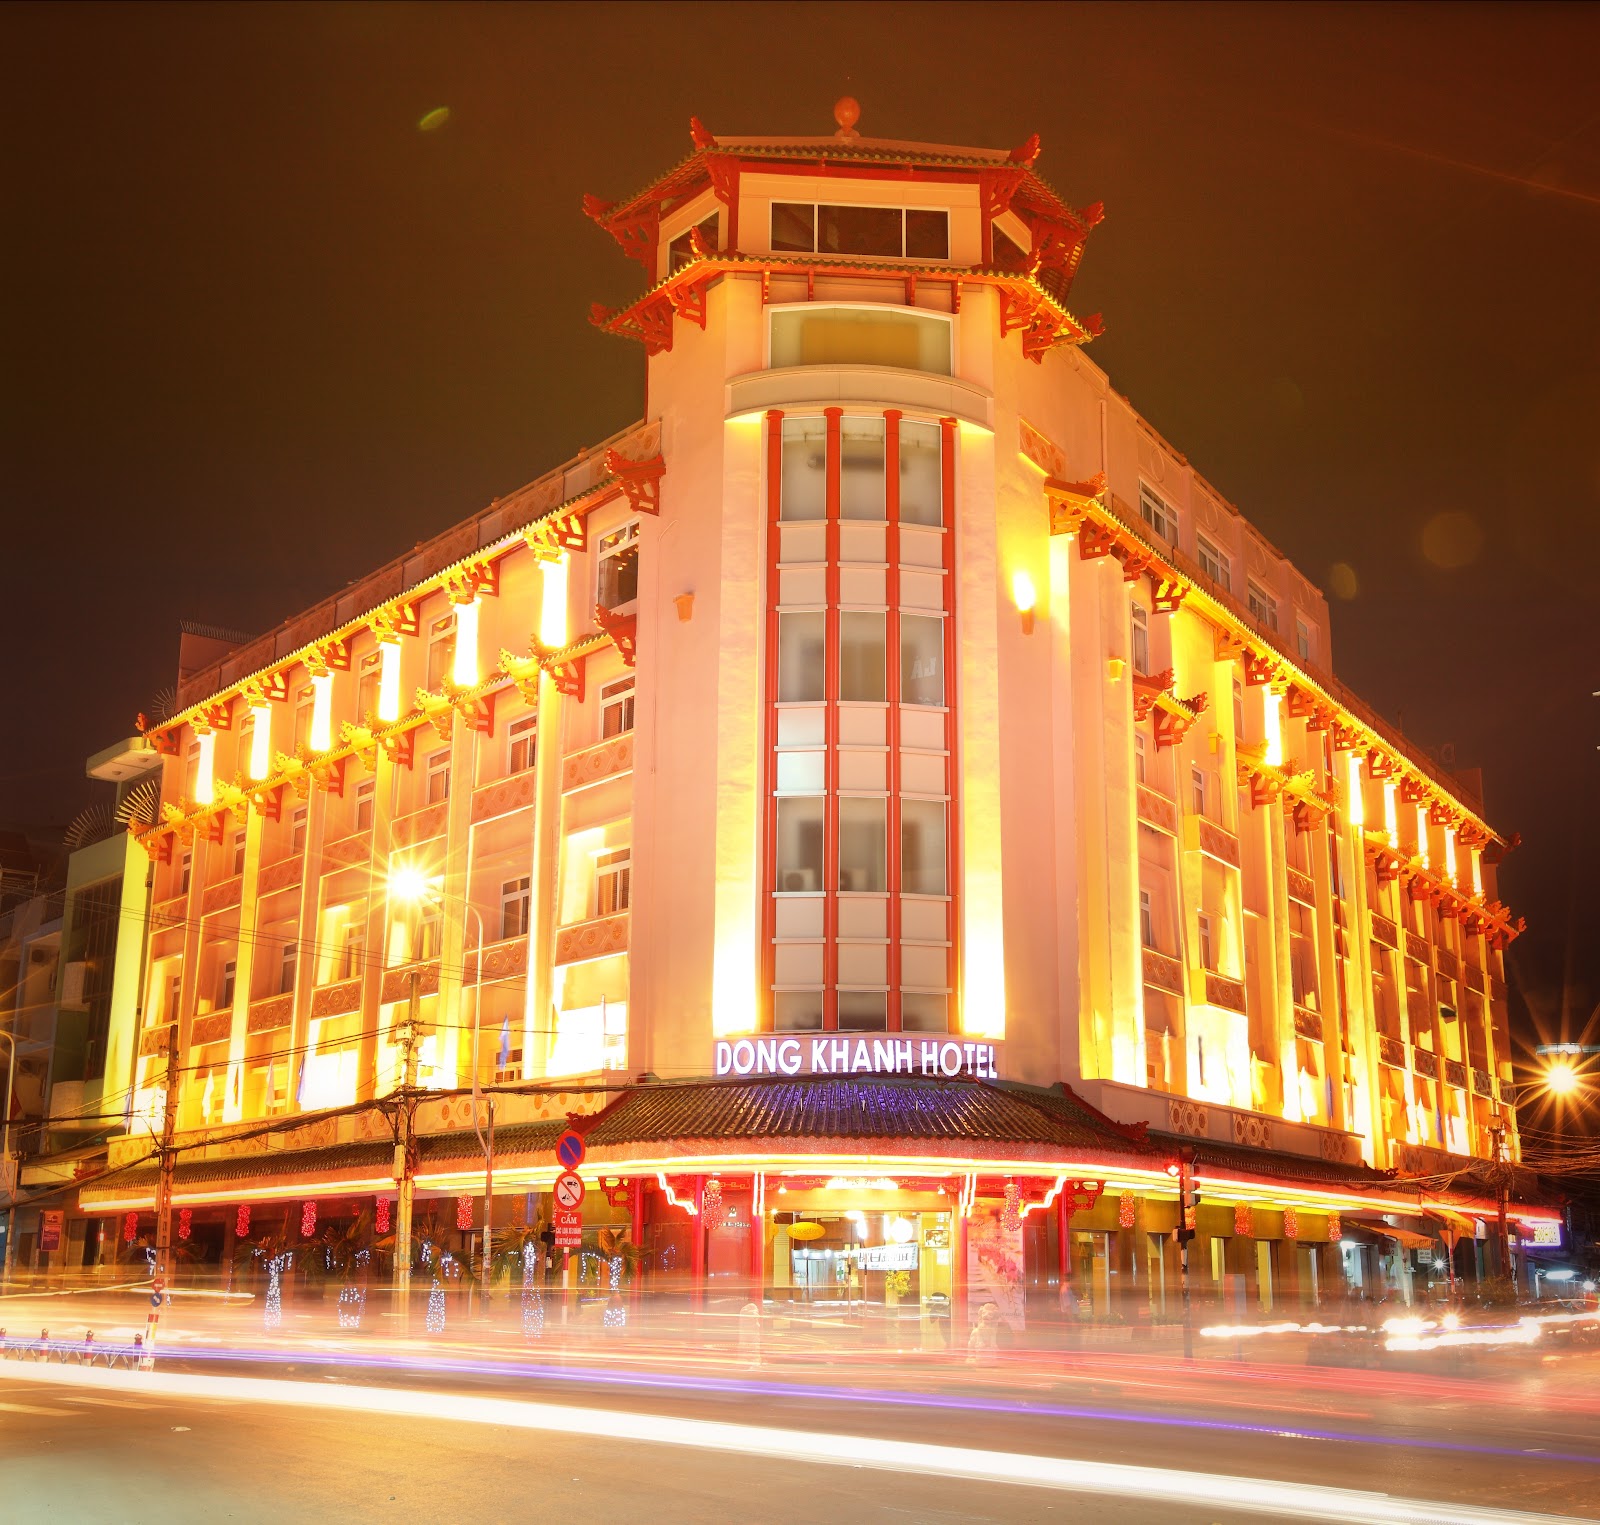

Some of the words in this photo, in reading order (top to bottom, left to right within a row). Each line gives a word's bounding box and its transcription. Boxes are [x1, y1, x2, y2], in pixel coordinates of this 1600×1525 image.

[716, 1039, 802, 1075] DONG
[811, 1039, 912, 1074] KHANH
[921, 1040, 998, 1079] HOTEL
[793, 1227, 820, 1236] Reception
